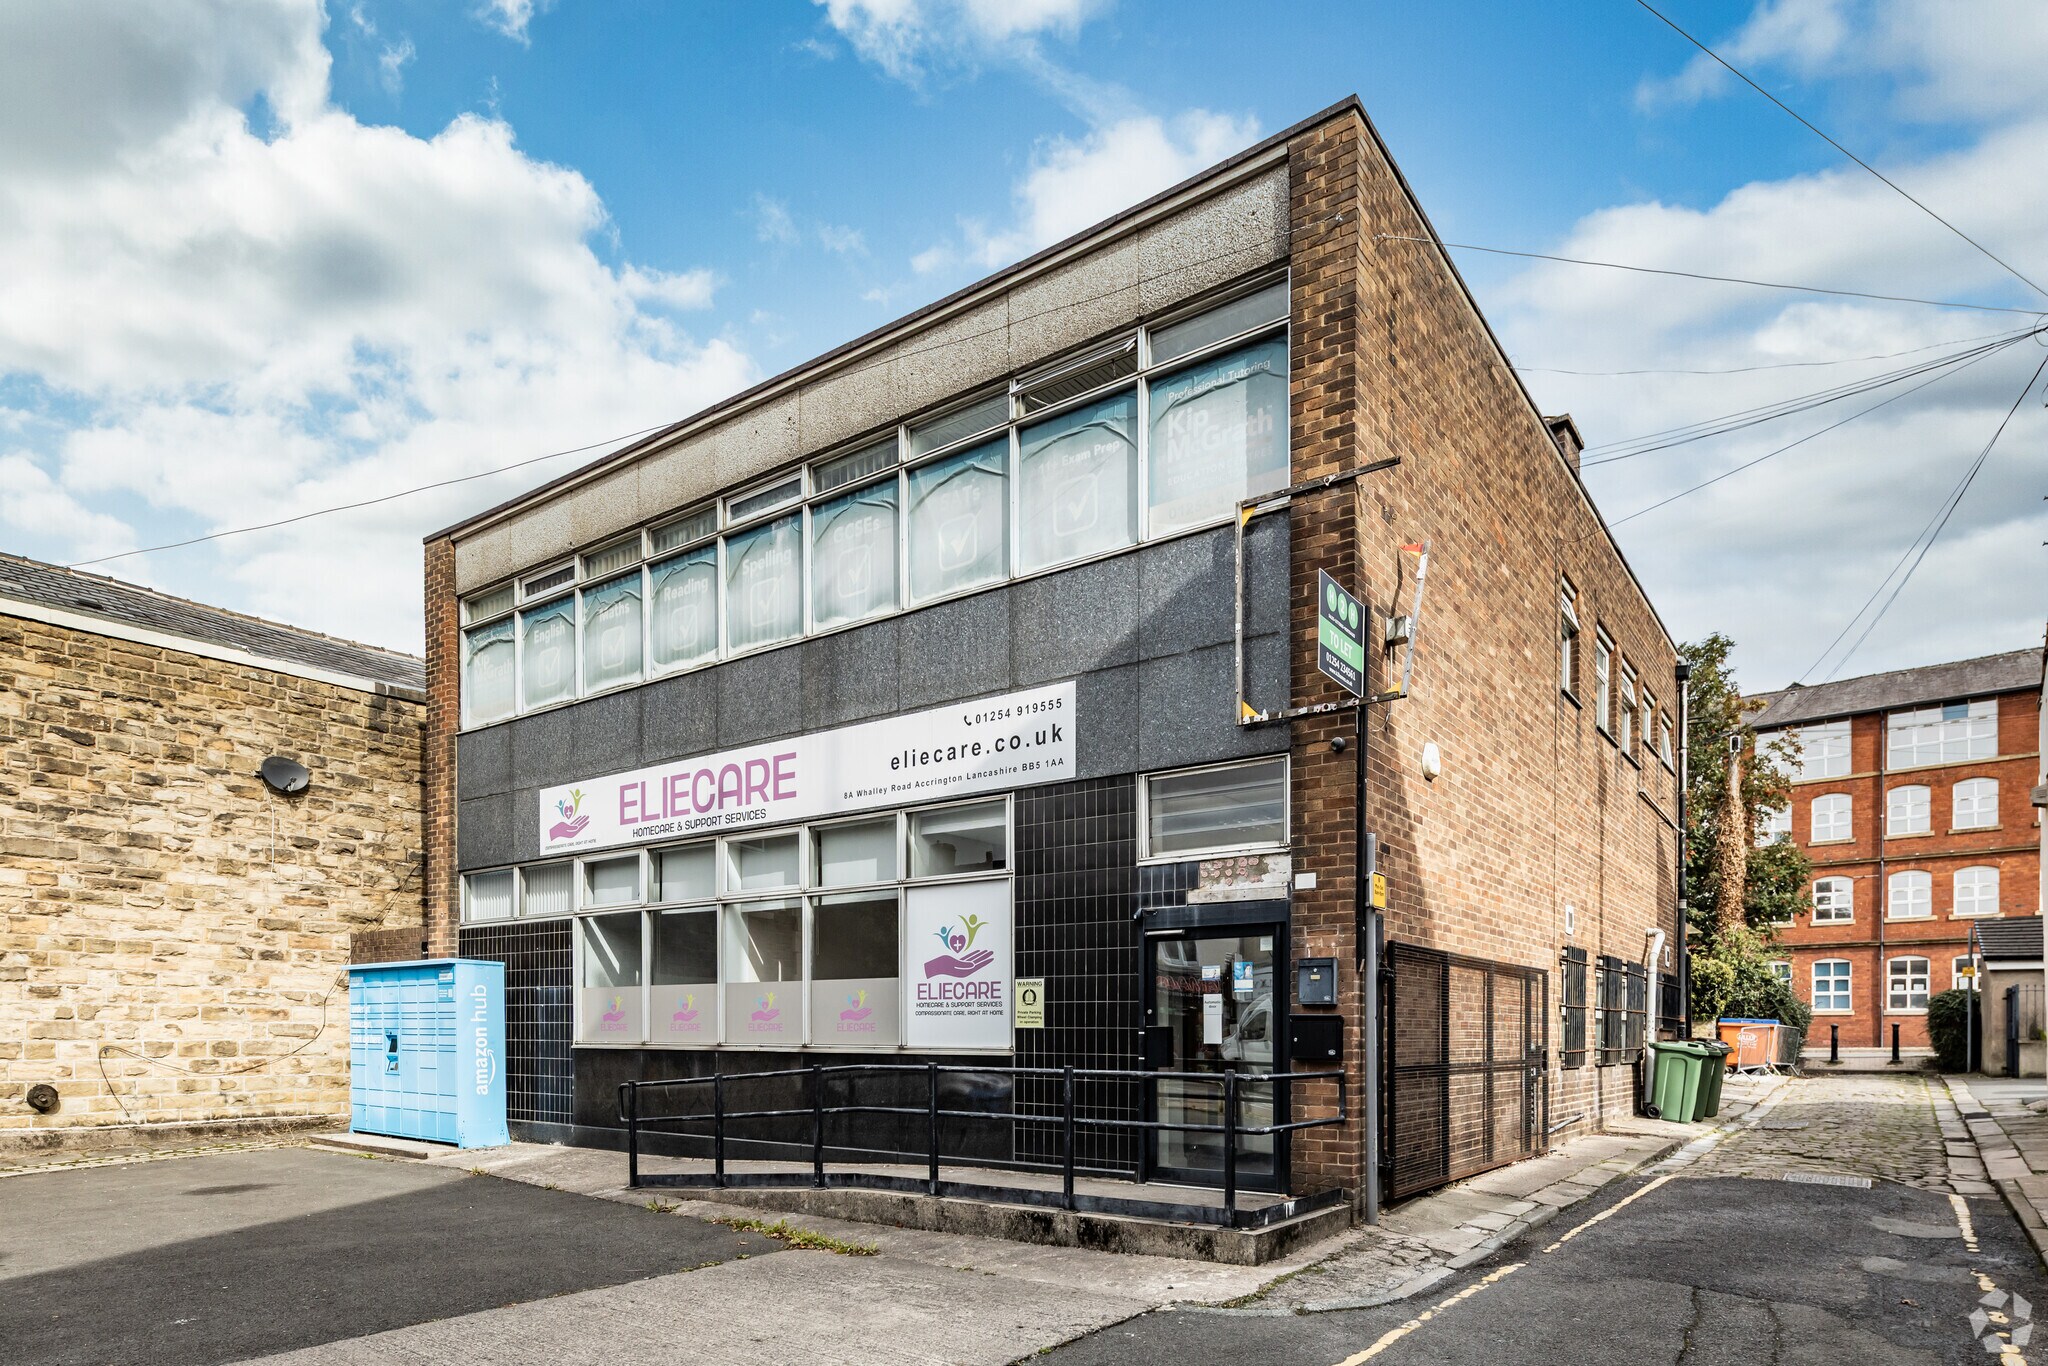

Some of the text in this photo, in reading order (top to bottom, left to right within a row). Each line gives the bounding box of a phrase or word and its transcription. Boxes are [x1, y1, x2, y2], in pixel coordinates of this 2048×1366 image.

[1168, 359, 1271, 402] Professional Tutoring
[1167, 407, 1273, 464] McGrath
[1168, 406, 1209, 438] Kip
[1061, 449, 1091, 467] Exam
[1093, 440, 1120, 457] Prep
[833, 515, 881, 544] GCSEs
[742, 548, 792, 576] Spelling
[664, 577, 709, 602] Reading
[533, 622, 566, 644] English
[1330, 629, 1353, 660] TO LET
[975, 698, 1062, 724] 01254 919555
[890, 723, 1063, 771] eliecare.co.uk
[619, 752, 797, 826] ELIECARE
[843, 757, 1064, 800] 8A Whalley Road Accrington Lancashire BB5 1AA
[632, 808, 767, 838] HOMECARE & SUPPORT SERVICES
[917, 981, 1001, 1000] ELIECARE
[976, 1000, 1003, 1008] SERVICES
[469, 984, 489, 1096] amazon hub
[748, 1022, 784, 1032] ELIECARE
[836, 1022, 877, 1032] ELIECARE
